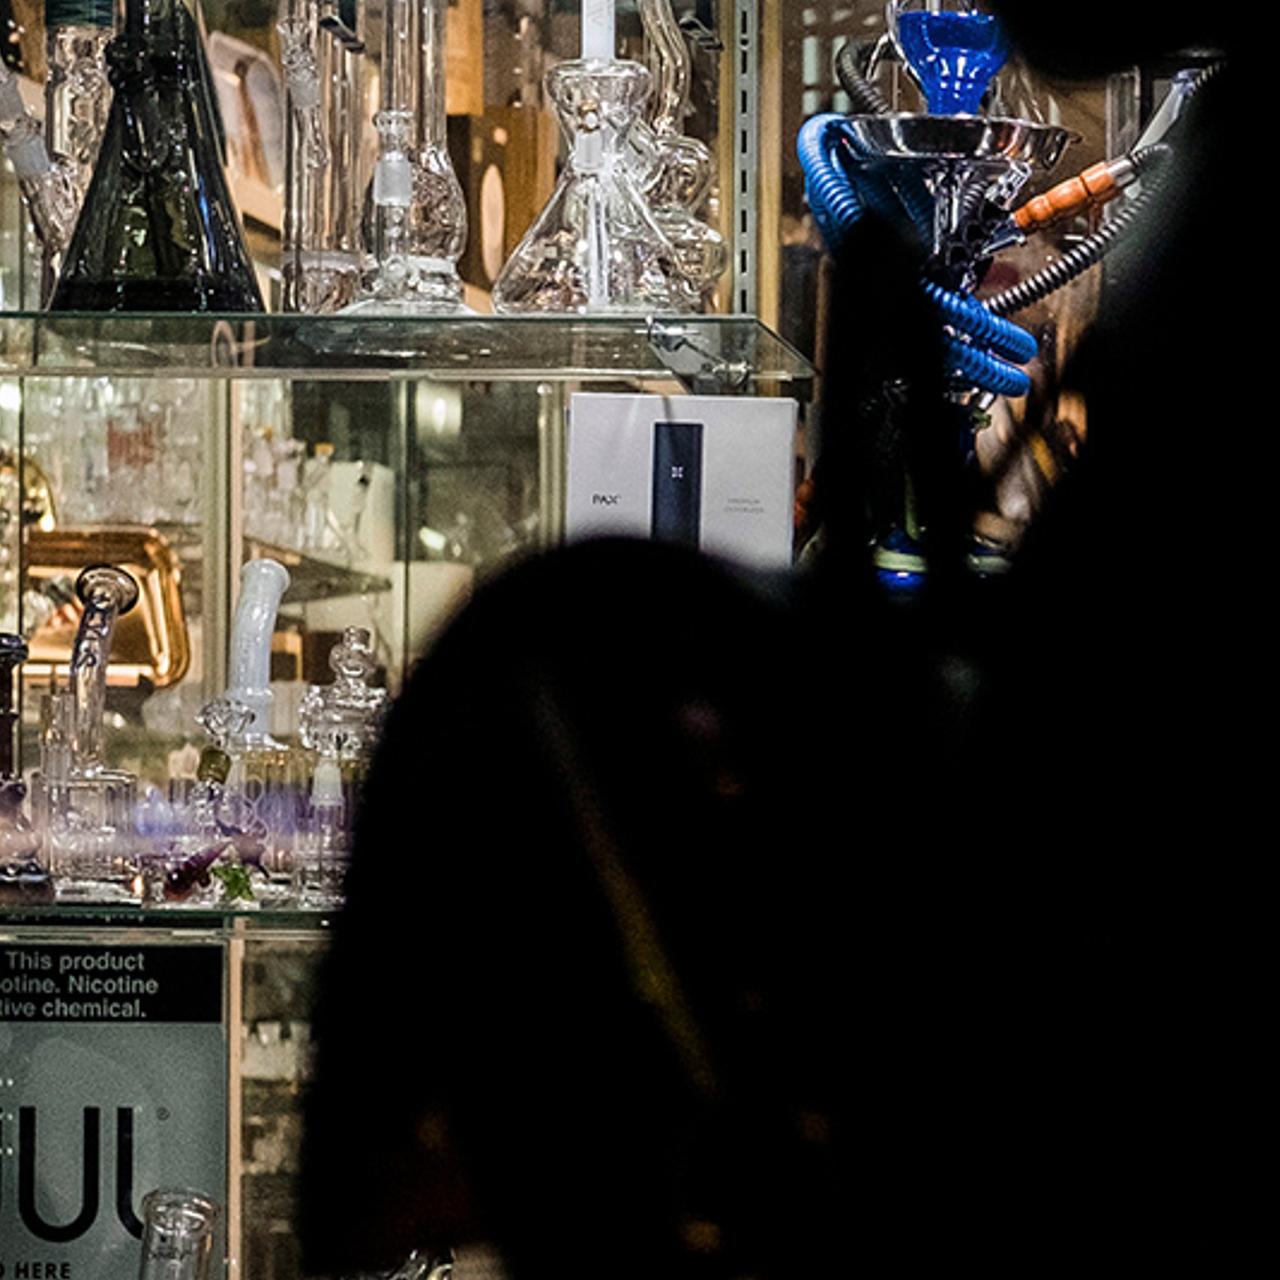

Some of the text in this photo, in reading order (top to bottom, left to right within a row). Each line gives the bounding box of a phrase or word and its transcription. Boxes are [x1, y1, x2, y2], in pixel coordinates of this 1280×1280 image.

[4, 950, 145, 974] This product
[67, 974, 160, 995] Nicotine
[41, 997, 148, 1019] chemical.
[15, 1263, 71, 1280] HERE
